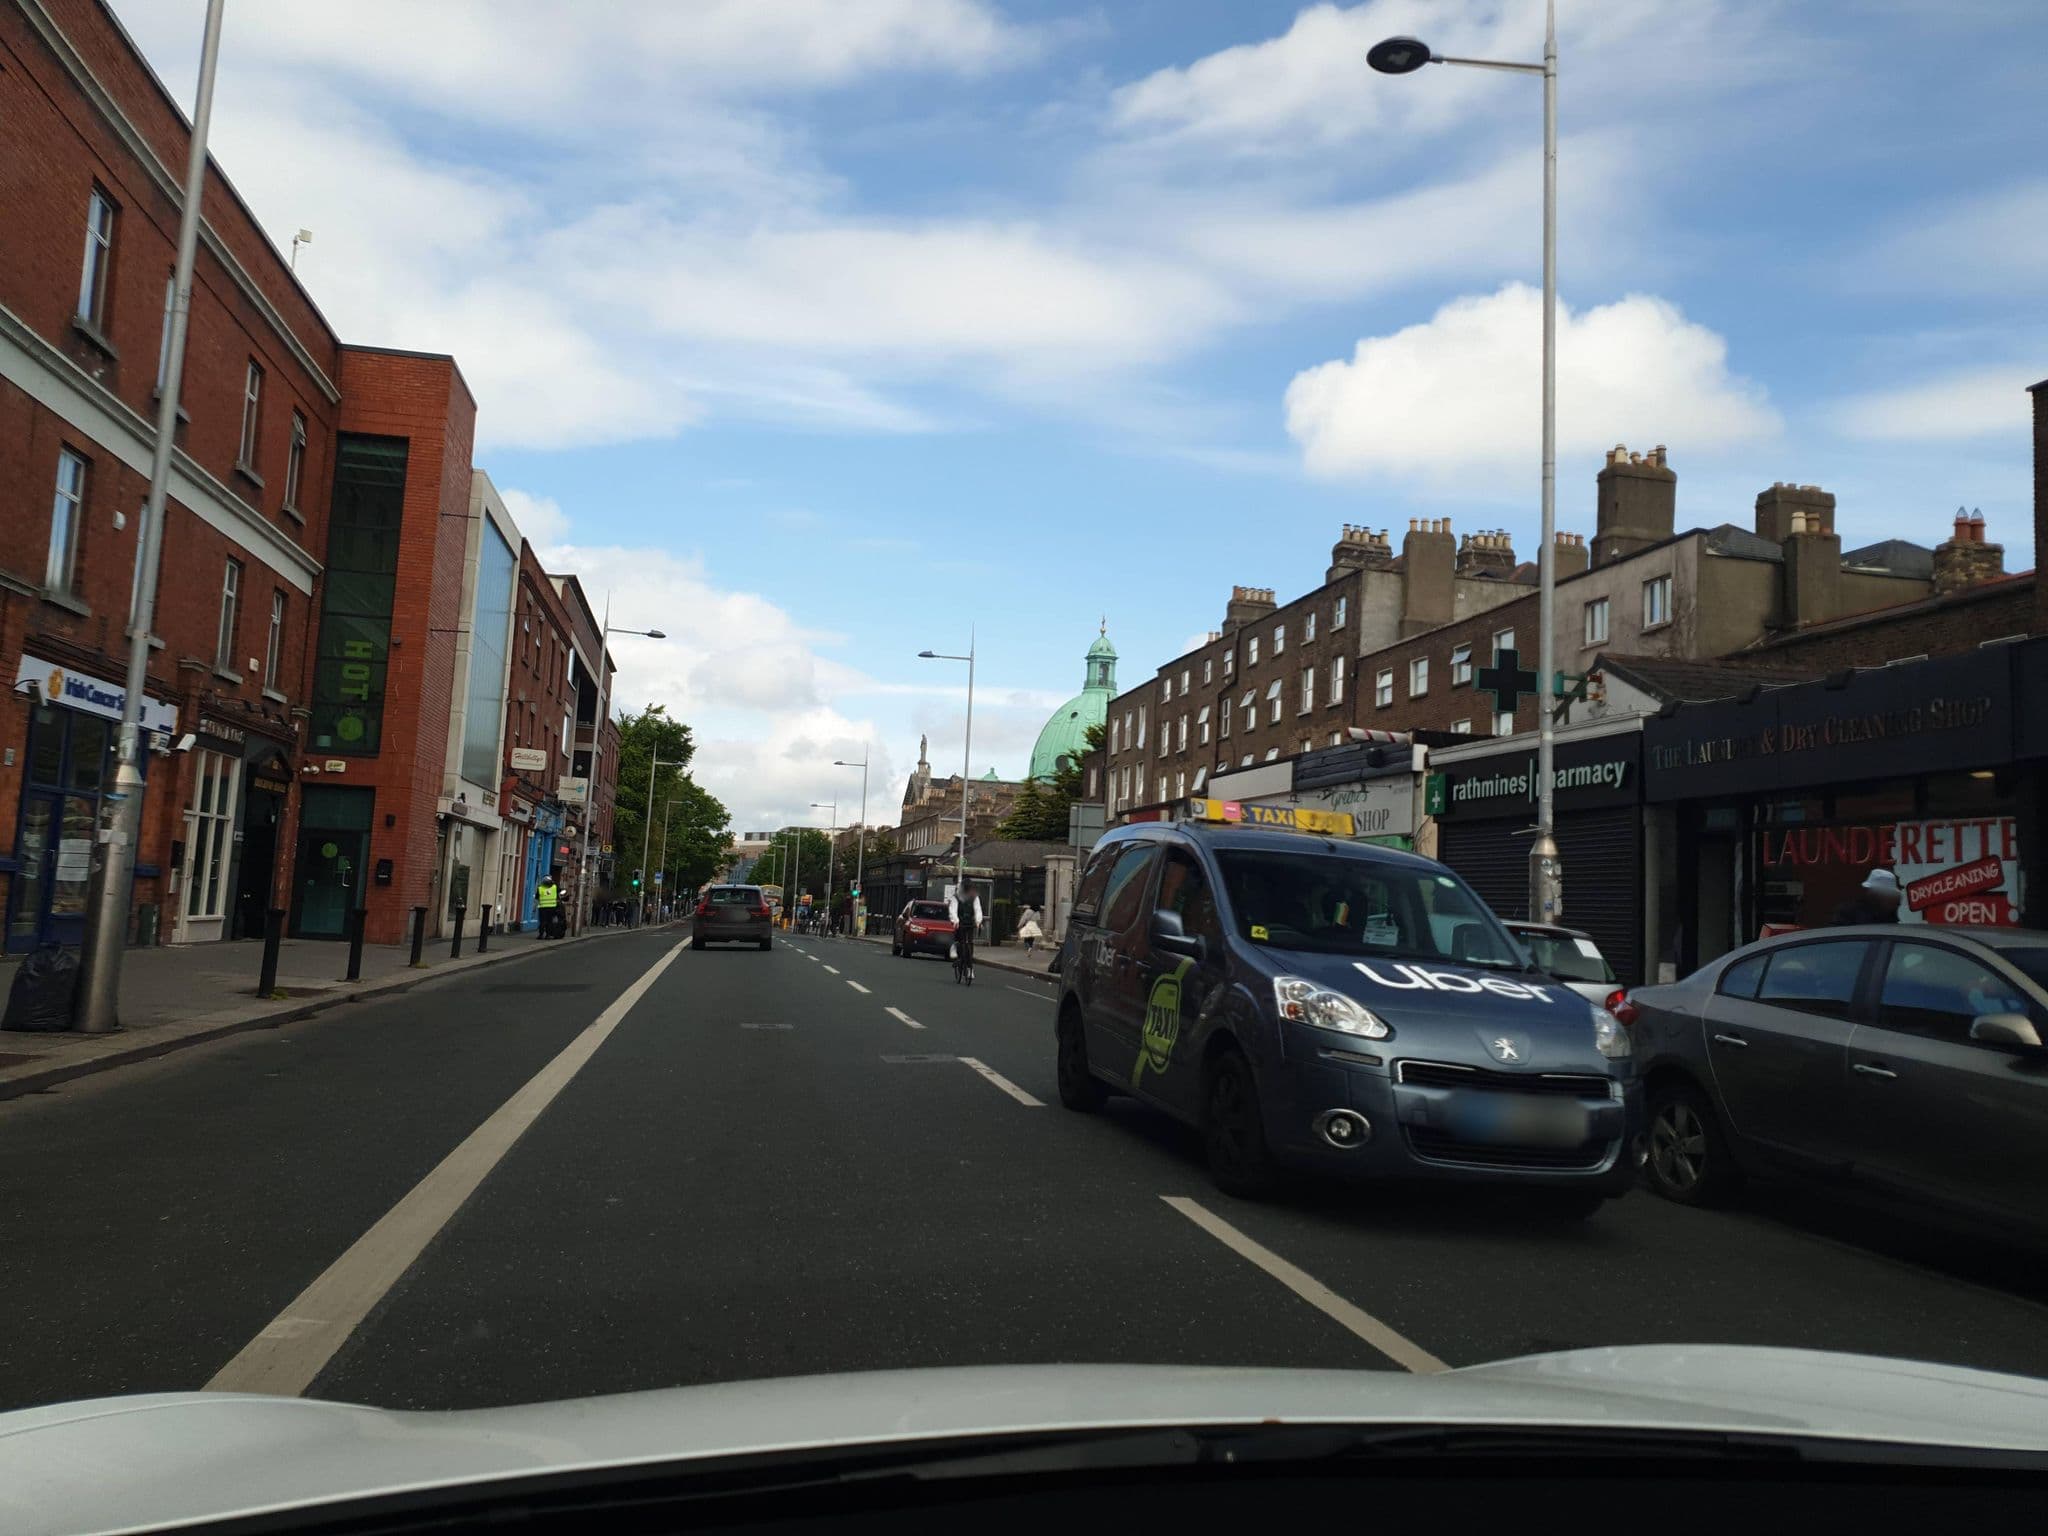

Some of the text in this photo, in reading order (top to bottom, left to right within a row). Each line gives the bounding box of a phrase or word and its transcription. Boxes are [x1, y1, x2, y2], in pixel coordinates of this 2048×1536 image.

[1761, 727, 1775, 754] &
[1782, 722, 1818, 753] DRY
[1452, 761, 1626, 801] rathmines armacy
[1356, 807, 1390, 832] SHOP
[1763, 818, 2017, 865] LAUNDERETTE
[1944, 903, 1997, 924] OPEN
[1351, 962, 1555, 1004] Uber
[1146, 1004, 1175, 1040] TAXI
